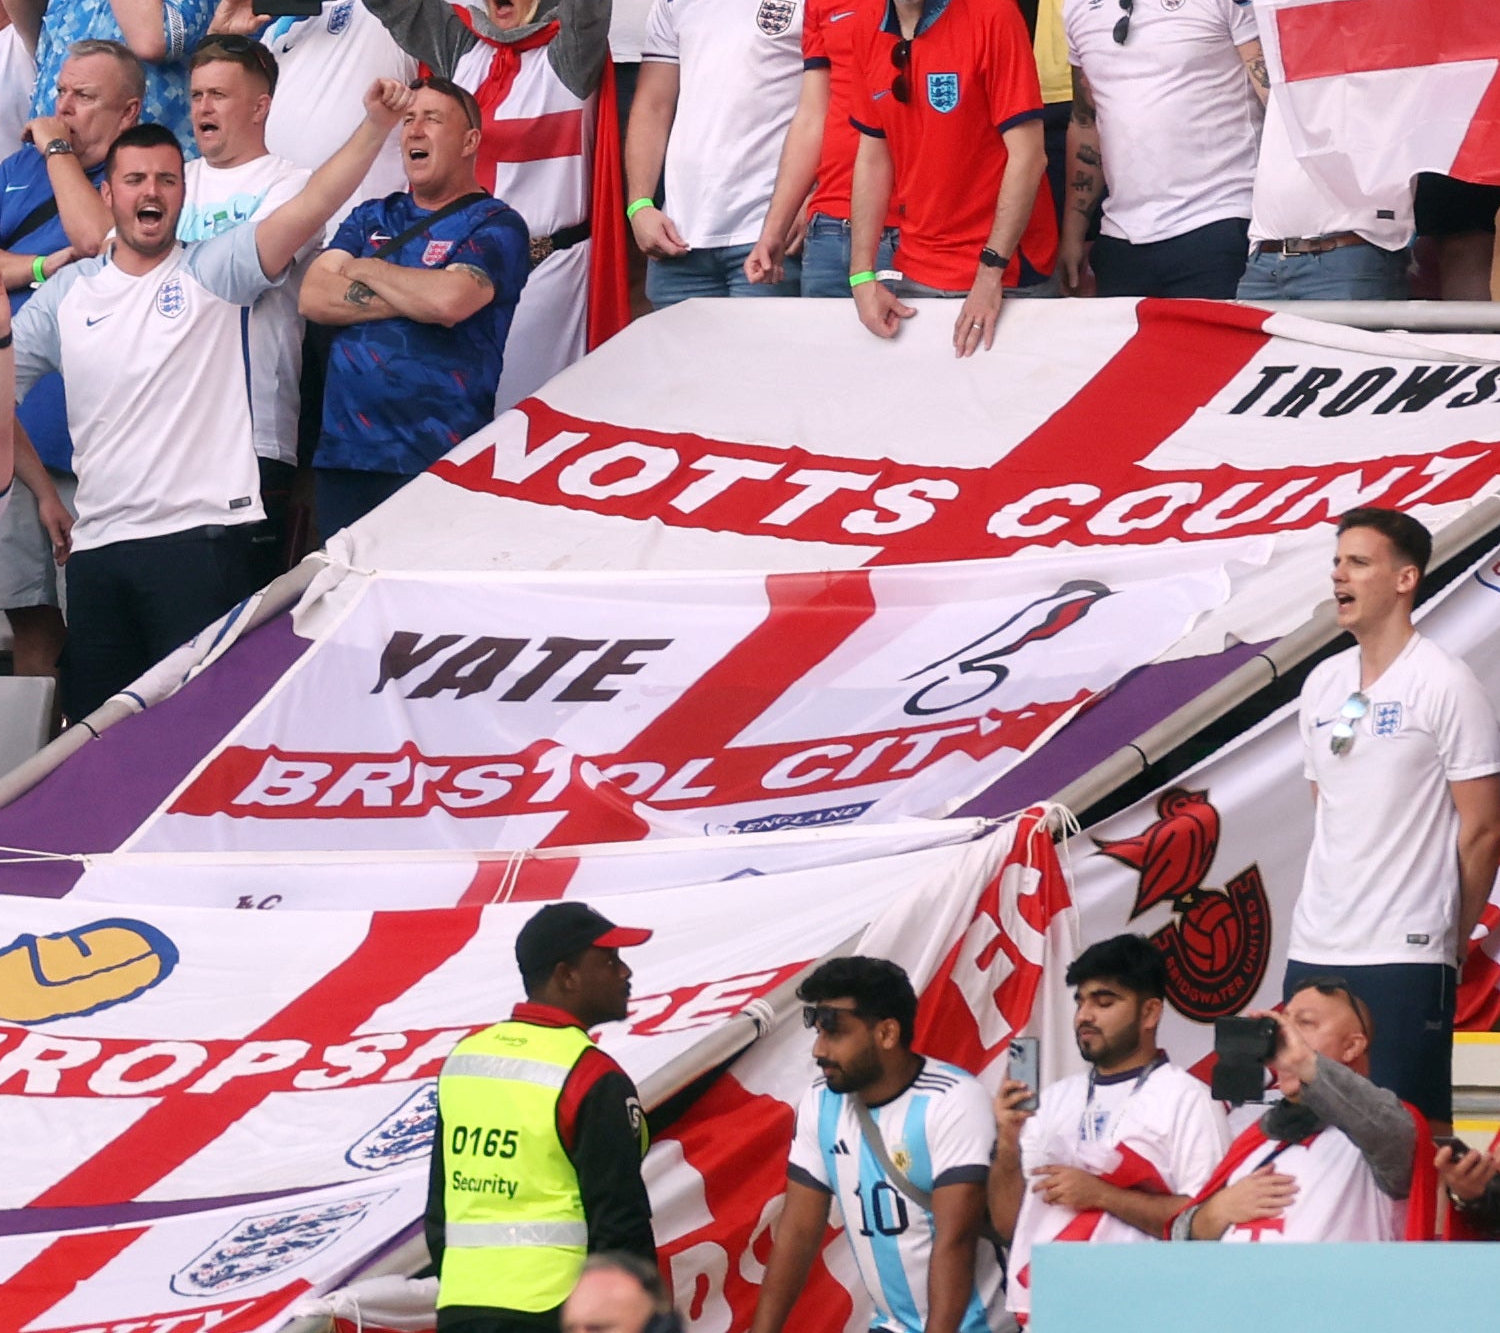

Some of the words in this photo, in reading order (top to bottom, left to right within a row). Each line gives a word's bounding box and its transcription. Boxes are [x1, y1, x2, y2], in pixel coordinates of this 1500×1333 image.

[453, 422, 962, 511] NOTTS
[370, 630, 676, 702] YATE
[232, 745, 716, 810] BRISTOL
[743, 806, 864, 834] ENGLAND
[451, 1126, 519, 1160] 0165
[451, 1170, 518, 1200] Security
[855, 1182, 910, 1237] 10
